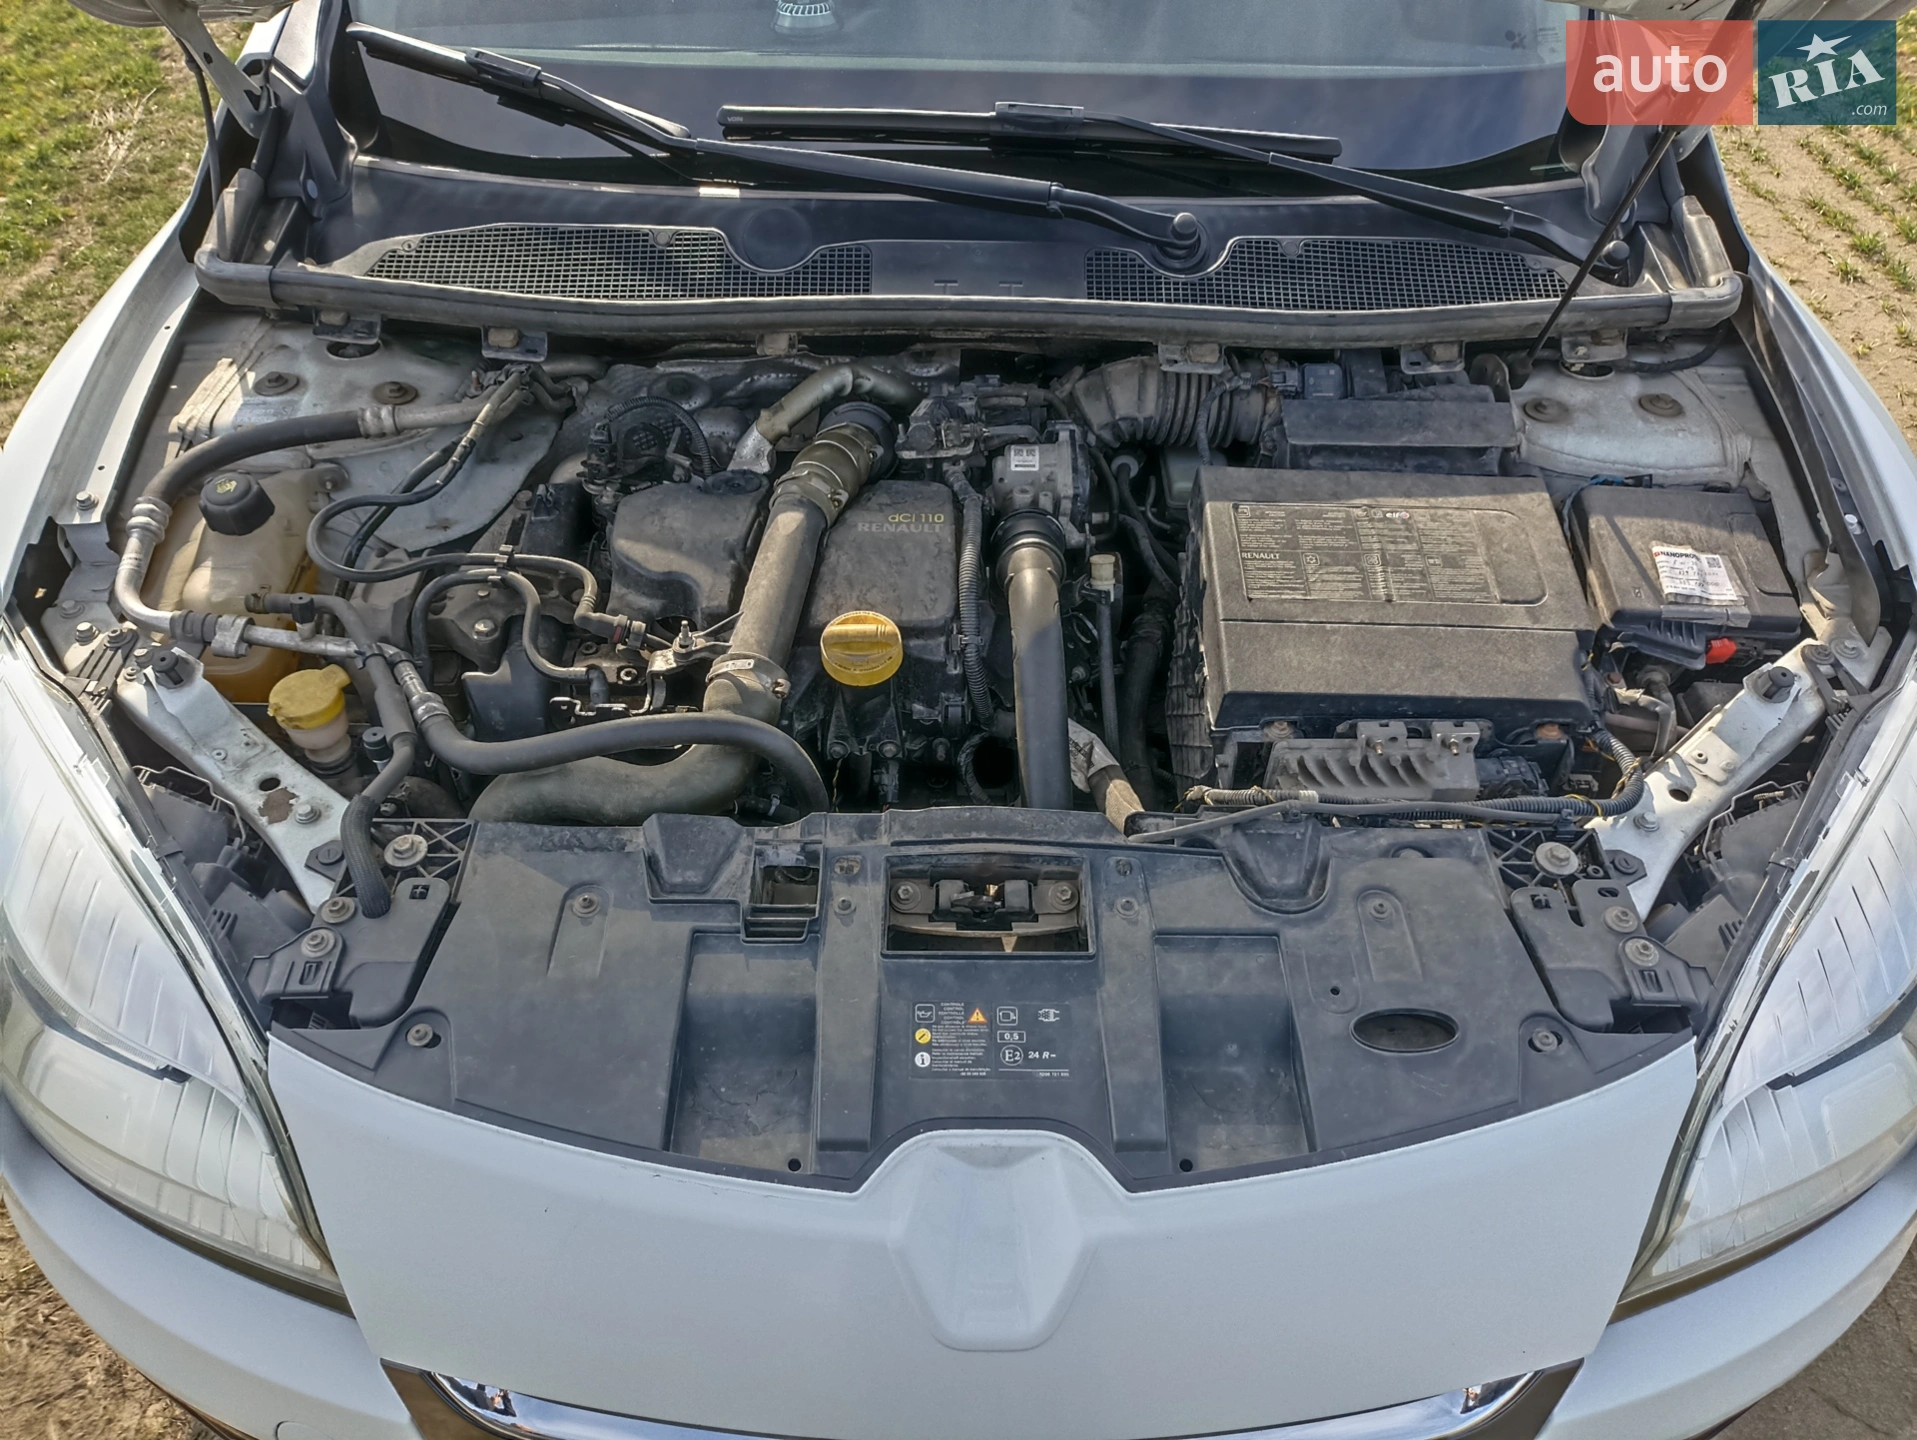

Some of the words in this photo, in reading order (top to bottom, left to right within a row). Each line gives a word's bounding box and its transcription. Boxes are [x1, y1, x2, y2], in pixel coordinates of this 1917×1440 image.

[888, 513, 915, 522] dCi
[920, 513, 944, 522] 110
[857, 523, 944, 532] RENAULT
[1028, 1051, 1040, 1059] 24
